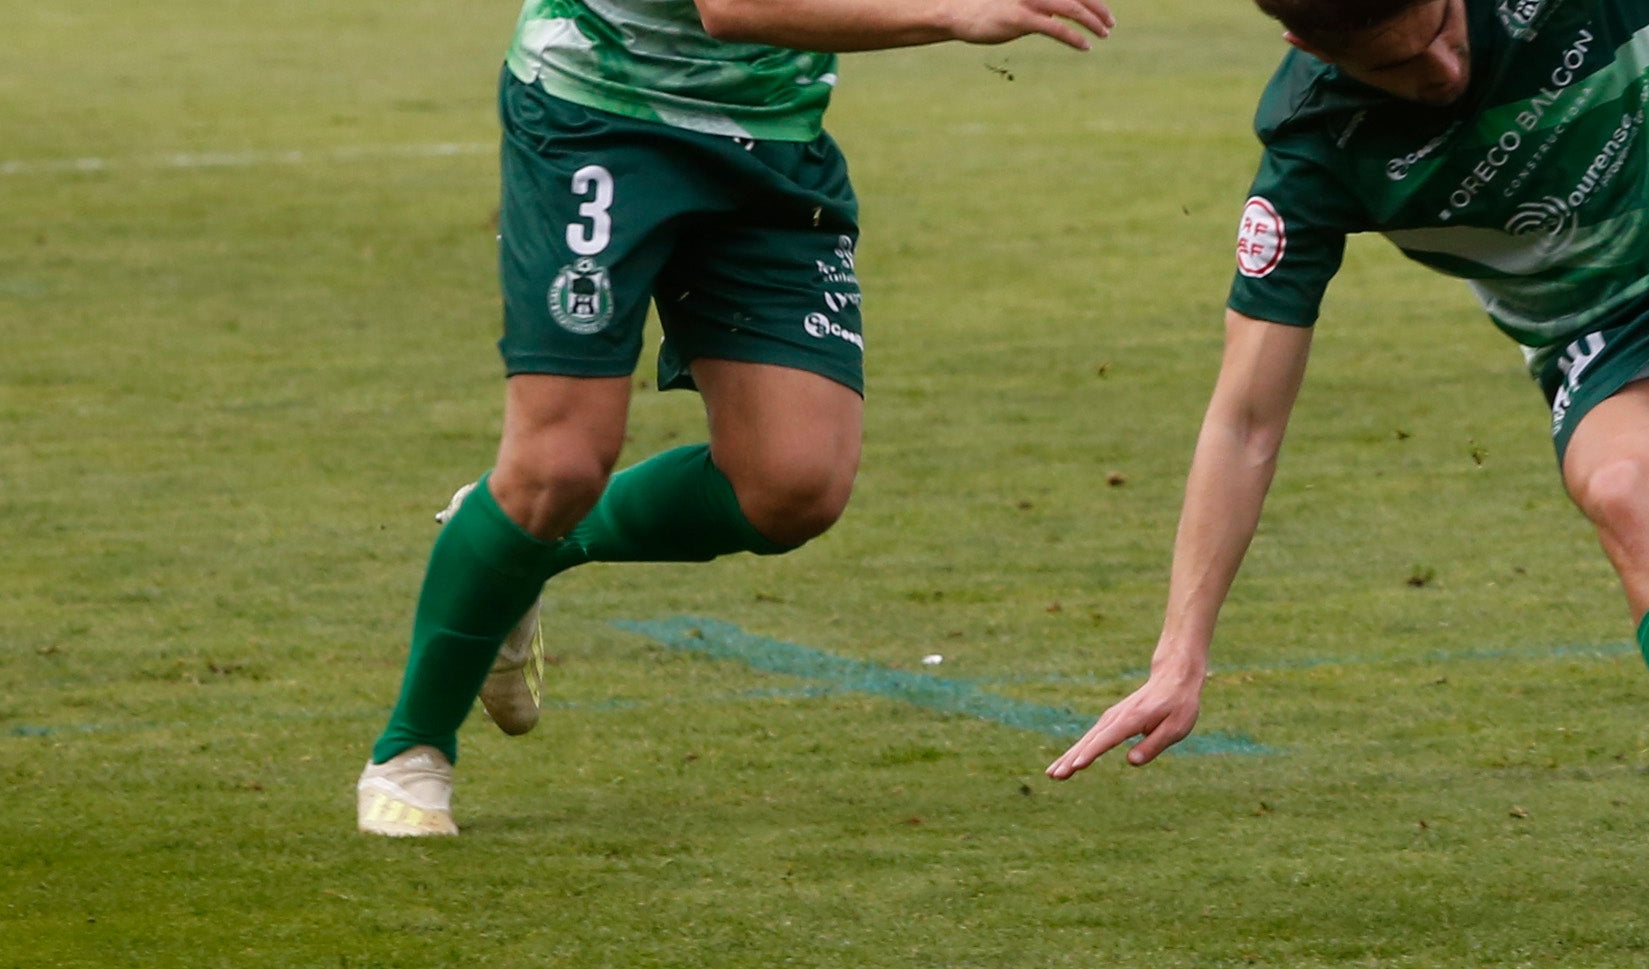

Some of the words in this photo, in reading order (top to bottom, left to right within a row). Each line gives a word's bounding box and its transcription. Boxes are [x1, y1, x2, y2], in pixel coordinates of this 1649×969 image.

[1449, 130, 1522, 209] ORECO
[1514, 28, 1595, 132] BALCÓN
[1503, 86, 1593, 199] CONSTRUCTORA
[1567, 112, 1632, 209] ourense
[565, 164, 615, 256] 3
